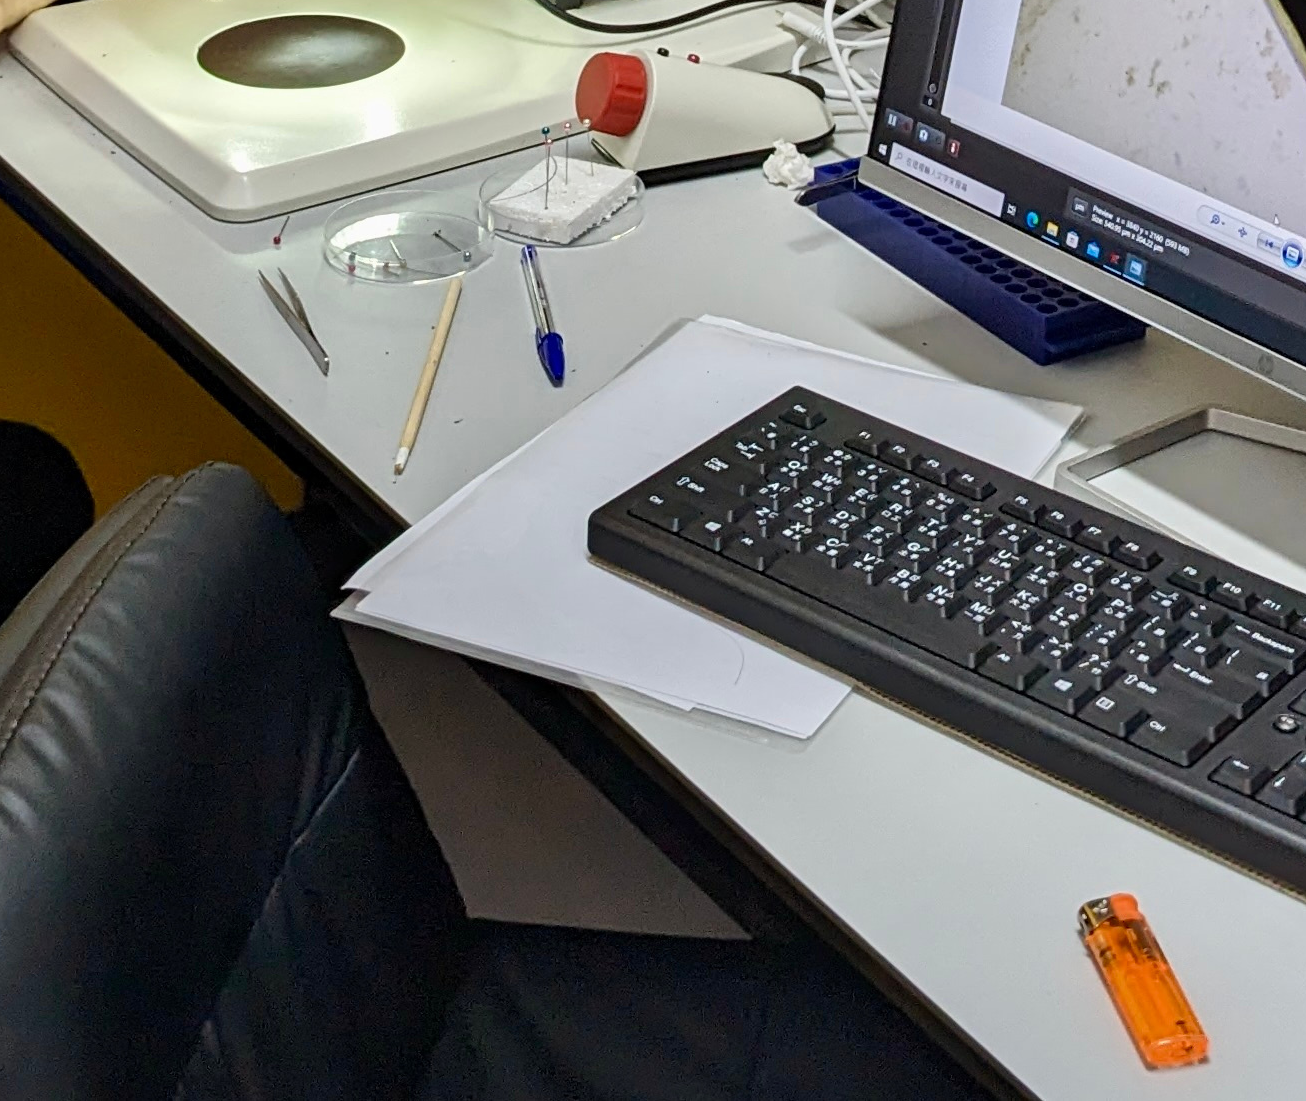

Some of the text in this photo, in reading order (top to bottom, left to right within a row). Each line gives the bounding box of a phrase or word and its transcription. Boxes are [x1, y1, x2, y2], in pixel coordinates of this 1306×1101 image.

[1223, 582, 1242, 594] F10
[1263, 599, 1282, 611] F11
[1252, 631, 1295, 654] Backspace
[1189, 670, 1214, 686] Enter
